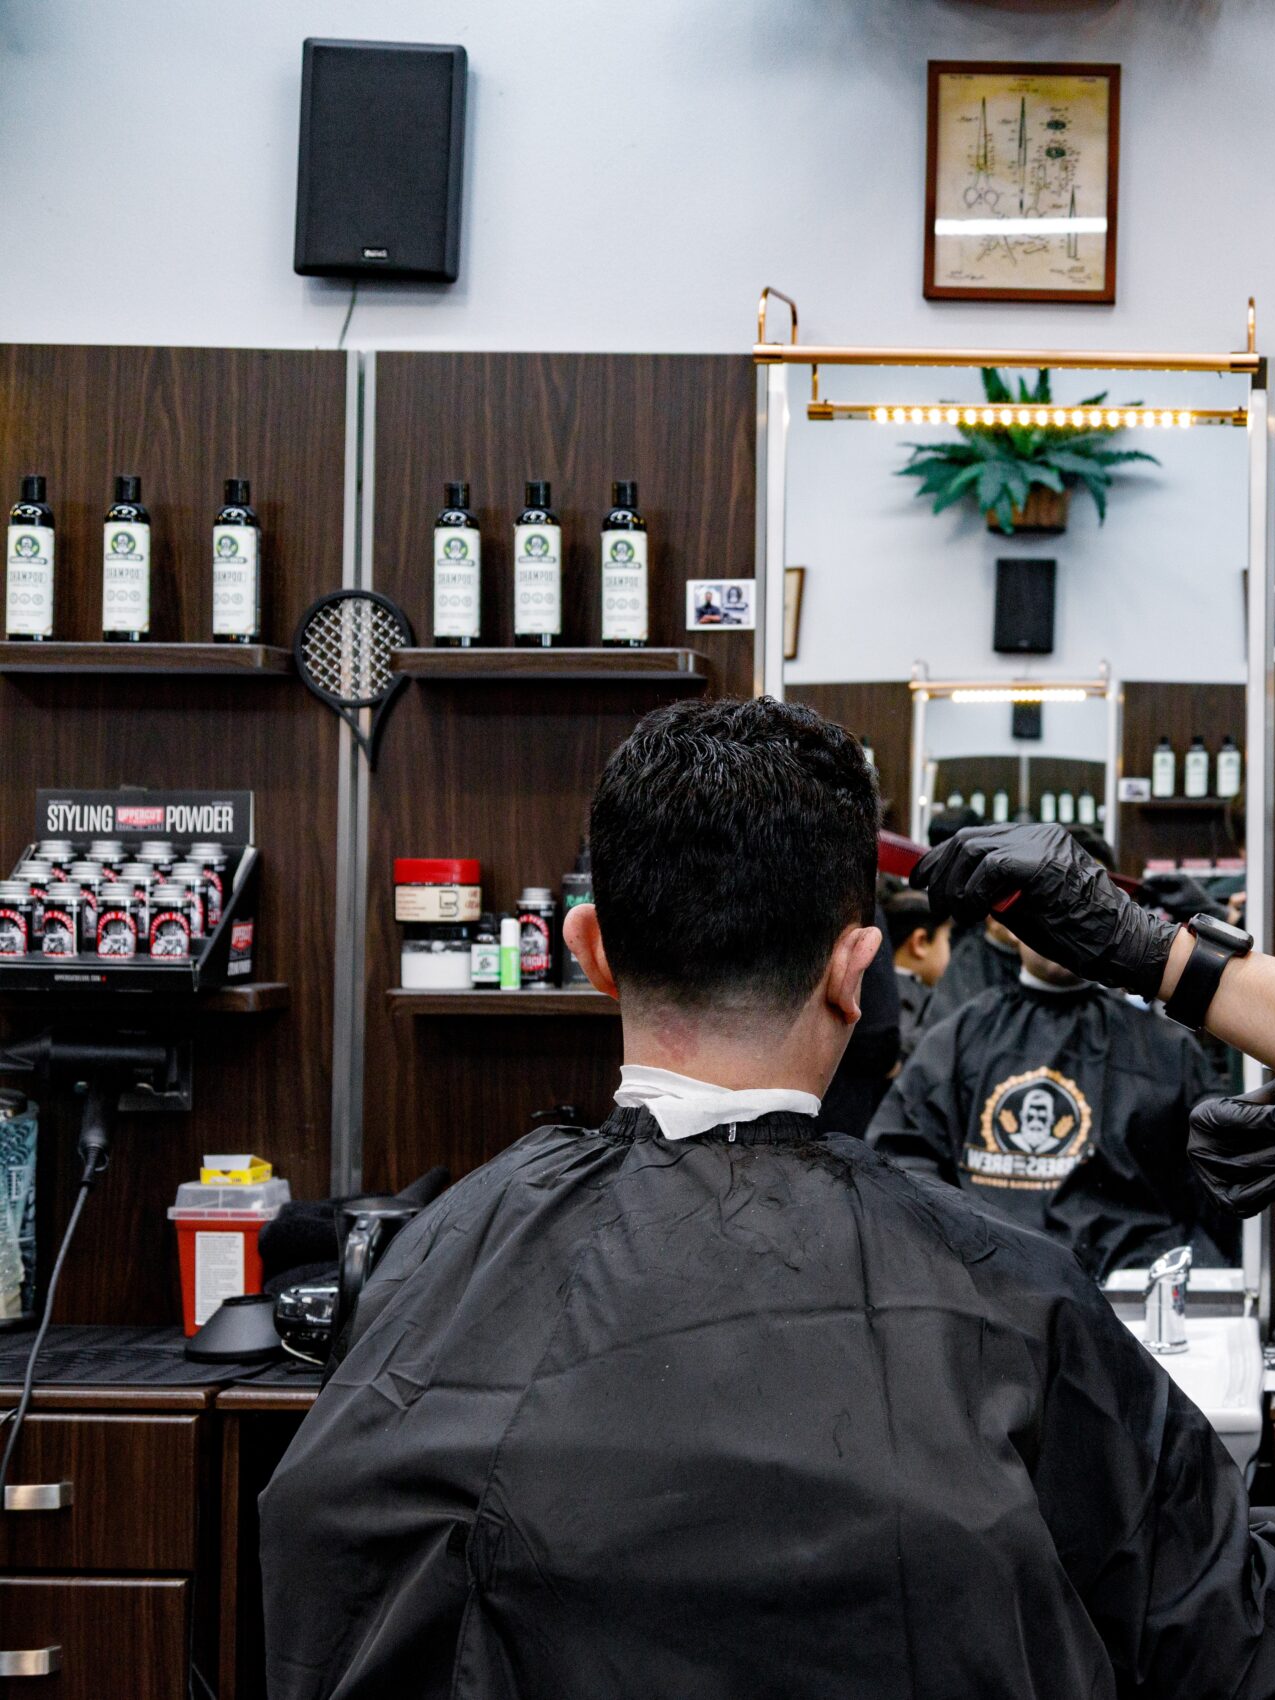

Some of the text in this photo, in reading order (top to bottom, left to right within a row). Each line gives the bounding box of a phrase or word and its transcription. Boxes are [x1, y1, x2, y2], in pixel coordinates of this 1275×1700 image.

[47, 804, 113, 832] STYLING
[116, 807, 164, 822] UPPERCUT
[165, 805, 234, 833] POWDER
